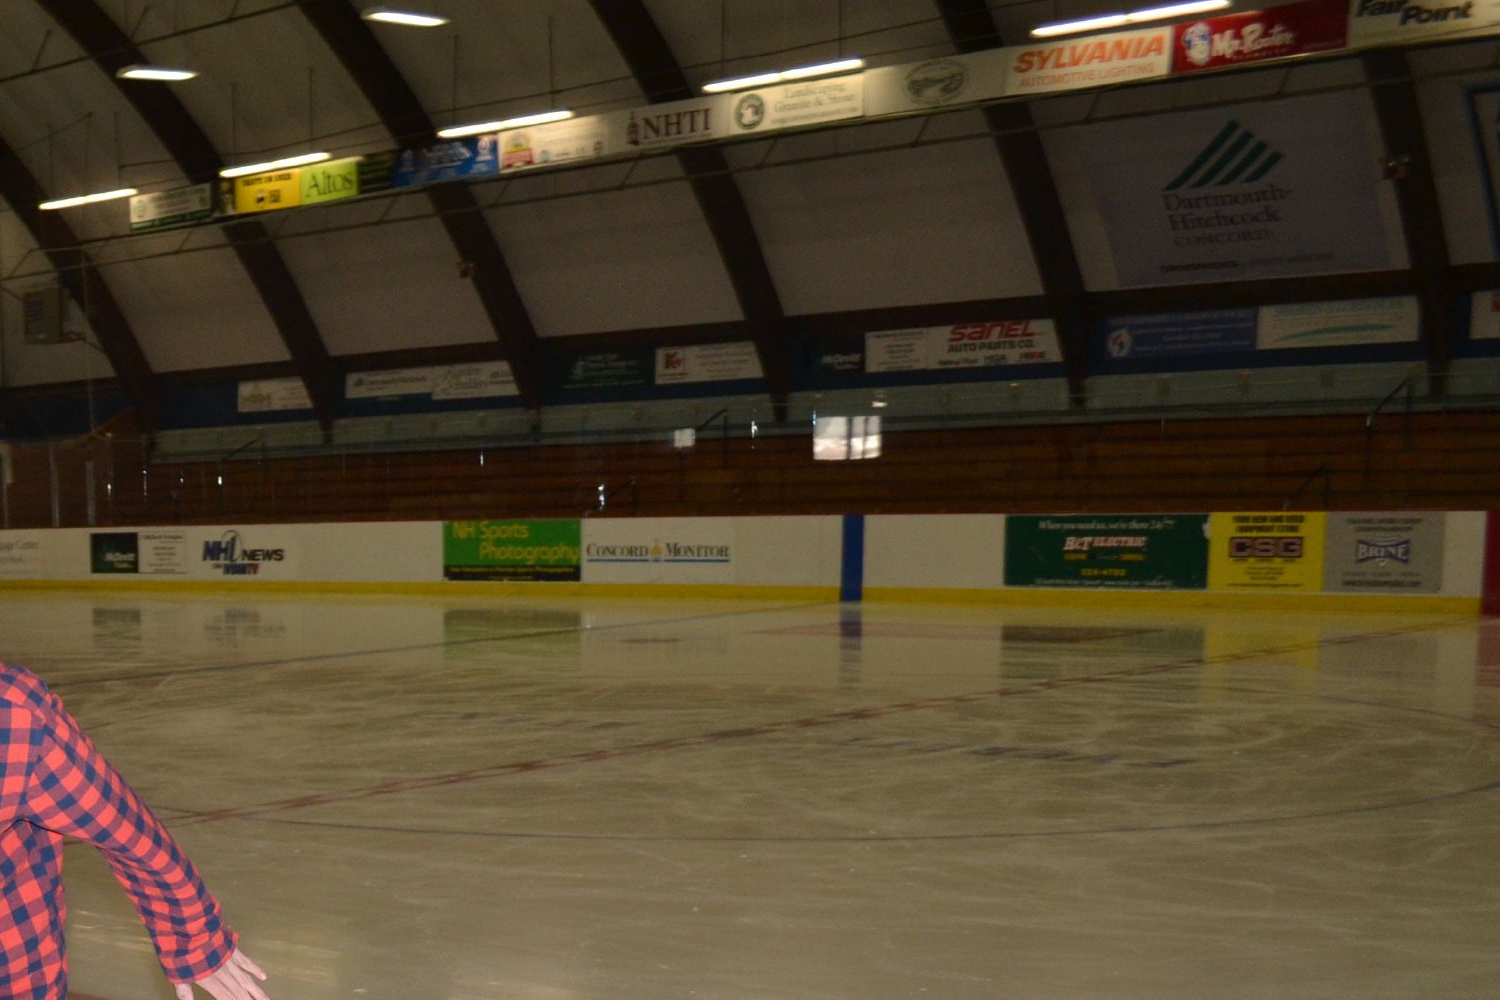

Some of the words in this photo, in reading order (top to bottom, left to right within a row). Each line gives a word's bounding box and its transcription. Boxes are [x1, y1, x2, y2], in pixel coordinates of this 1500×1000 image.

[1399, 0, 1472, 26] Point
[1012, 33, 1166, 74] SYLVANIA
[642, 108, 711, 139] NHTI
[1161, 183, 1295, 211] Dartmouth-
[1167, 206, 1283, 231] Hitchcock
[948, 343, 977, 353] AUTO
[978, 341, 1015, 351] PARTS
[452, 521, 475, 540] NH
[479, 521, 530, 543] Sports
[1092, 535, 1148, 548] ELECTRIC
[241, 547, 285, 562] NEWS
[478, 541, 581, 565] Photography
[586, 541, 650, 558] CONCORD
[664, 541, 730, 558] MONITOR
[1229, 536, 1303, 558] CSG
[1357, 541, 1411, 562] BRINE
